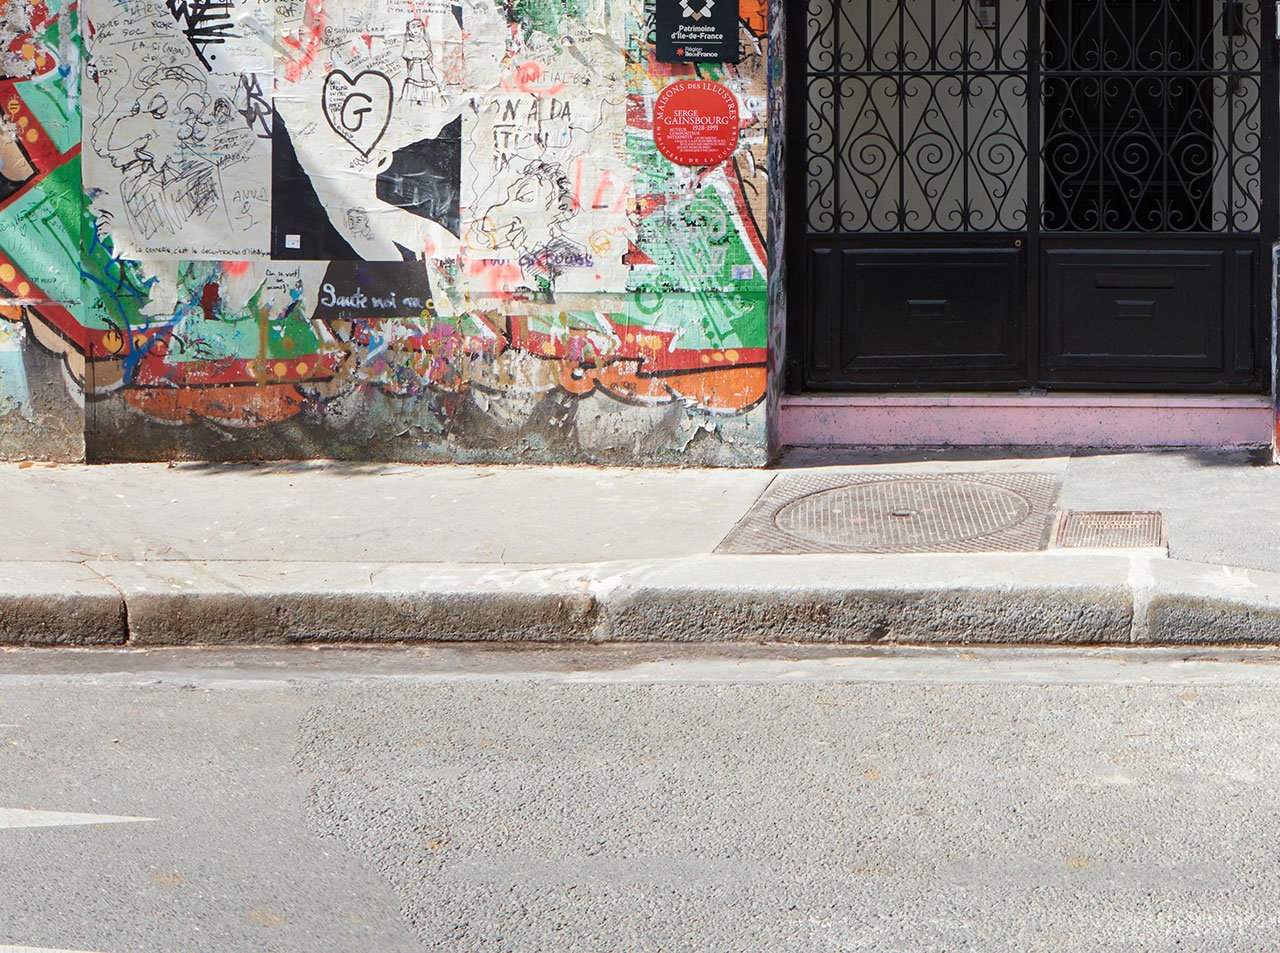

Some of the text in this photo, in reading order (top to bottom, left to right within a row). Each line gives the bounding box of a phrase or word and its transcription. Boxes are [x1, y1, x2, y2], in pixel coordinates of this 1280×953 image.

[678, 24, 716, 32] Patrimoine
[656, 83, 685, 120] MAISONS
[703, 83, 737, 120] ILLUSTRES
[664, 116, 729, 125] GAINSBOURG
[717, 125, 737, 159] CULTURE
